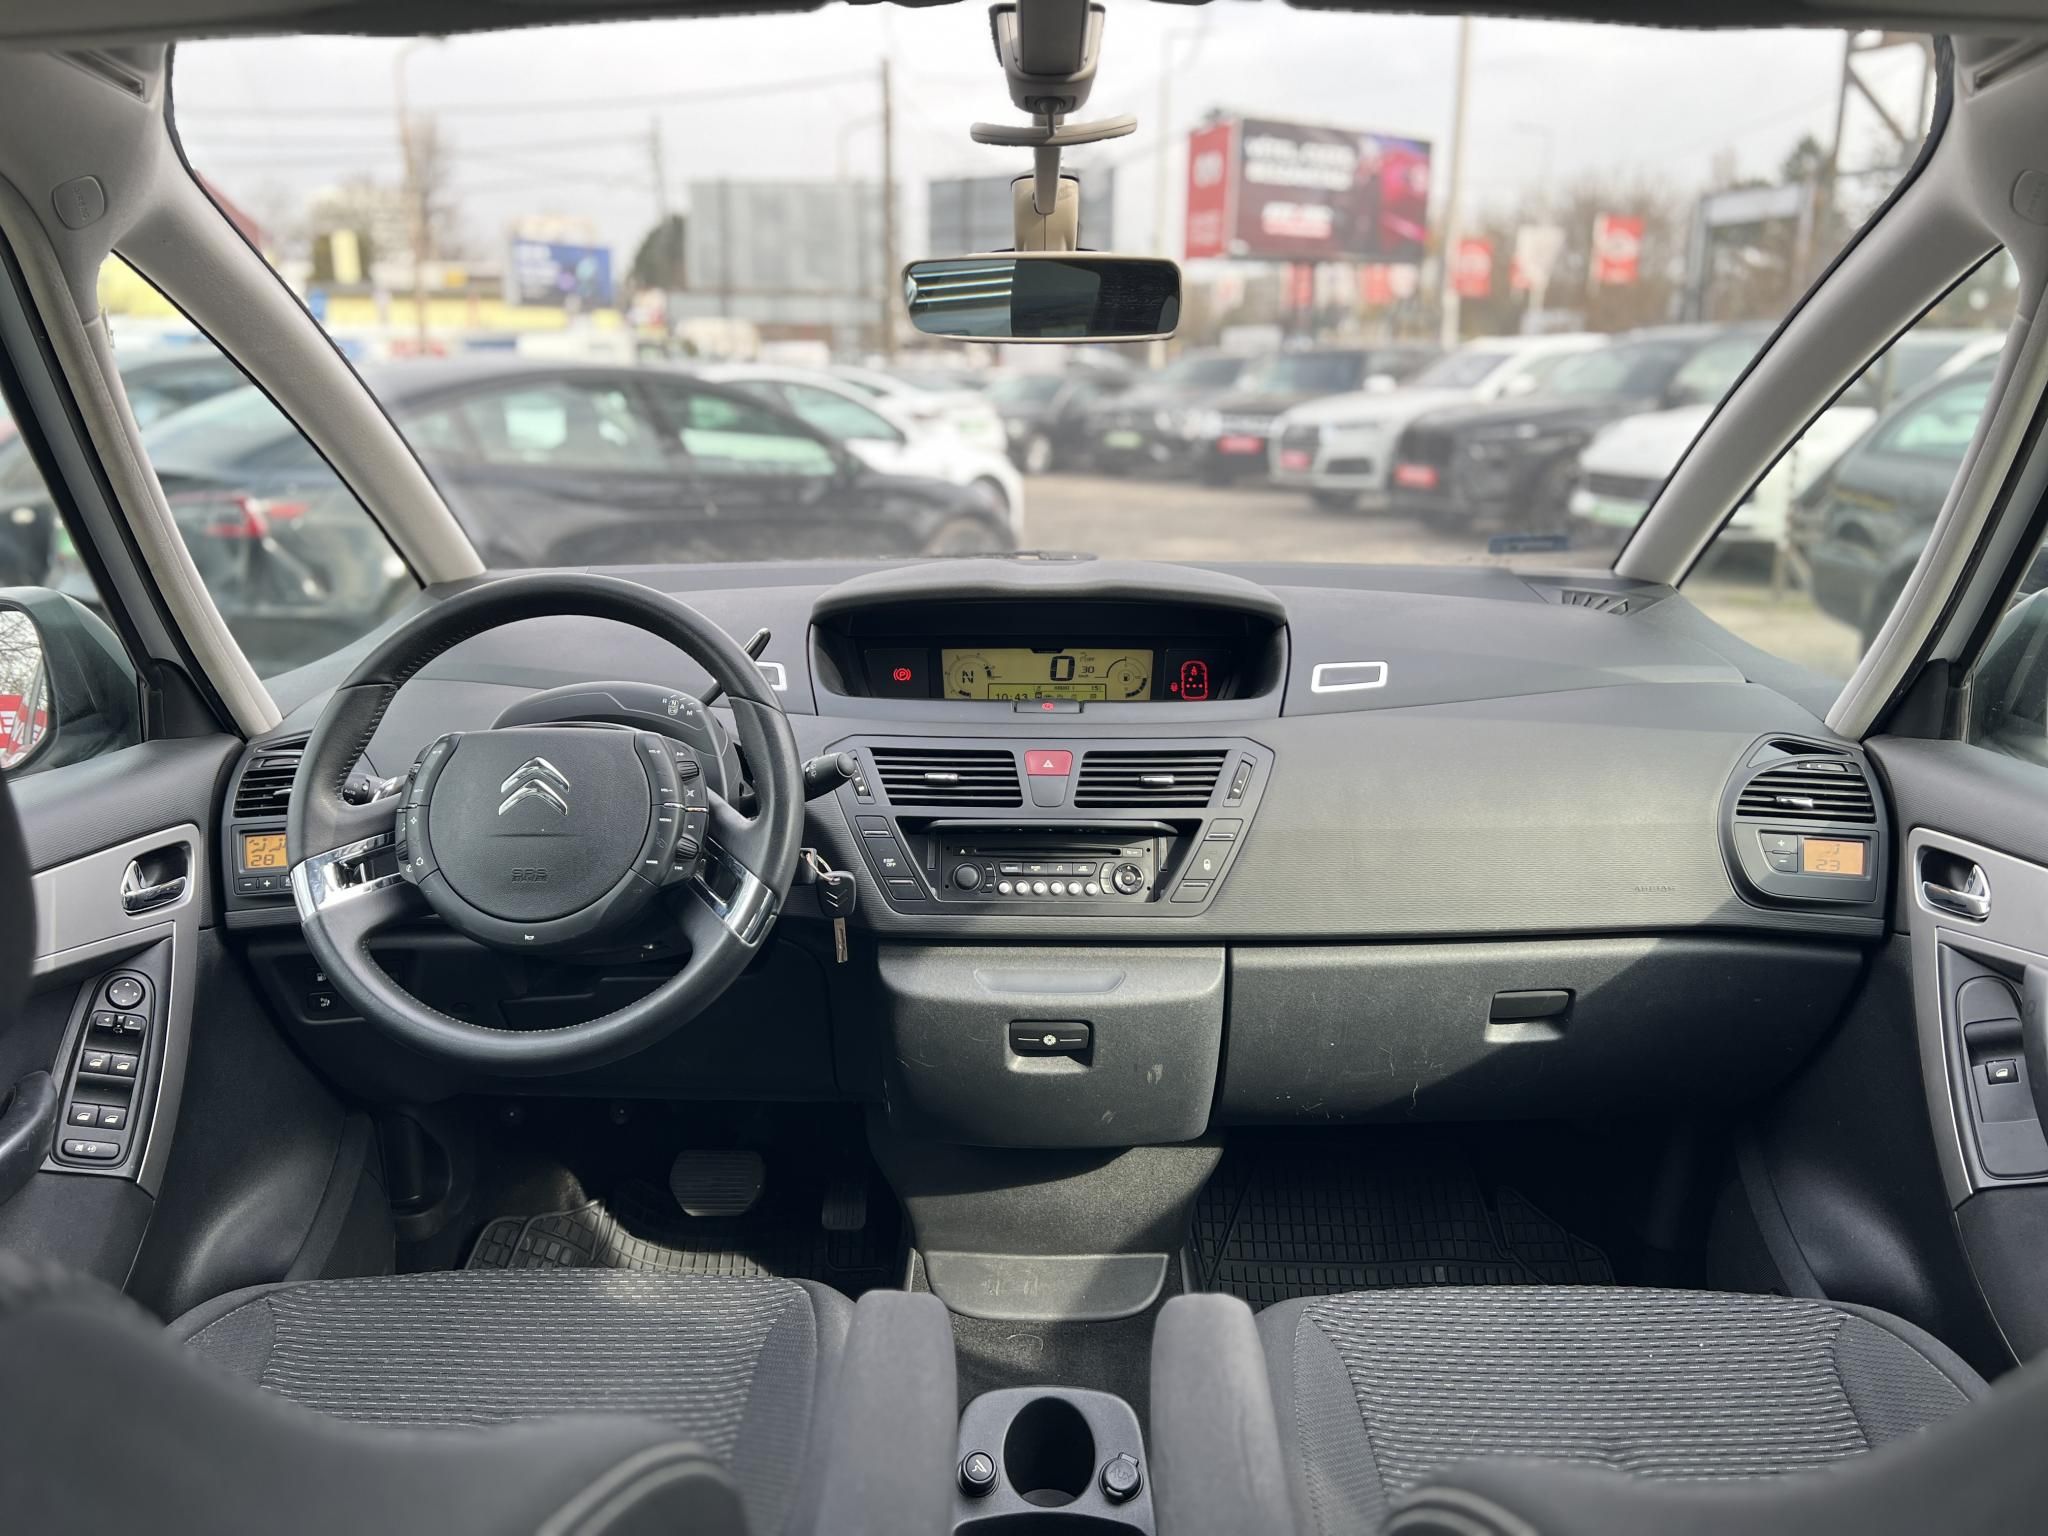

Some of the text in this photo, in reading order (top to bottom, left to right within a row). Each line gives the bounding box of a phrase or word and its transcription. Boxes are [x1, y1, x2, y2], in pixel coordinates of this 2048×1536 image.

[1050, 655, 1075, 681] 0
[1081, 665, 1095, 674] 30
[250, 854, 275, 867] 28
[1815, 859, 1841, 871] 23
